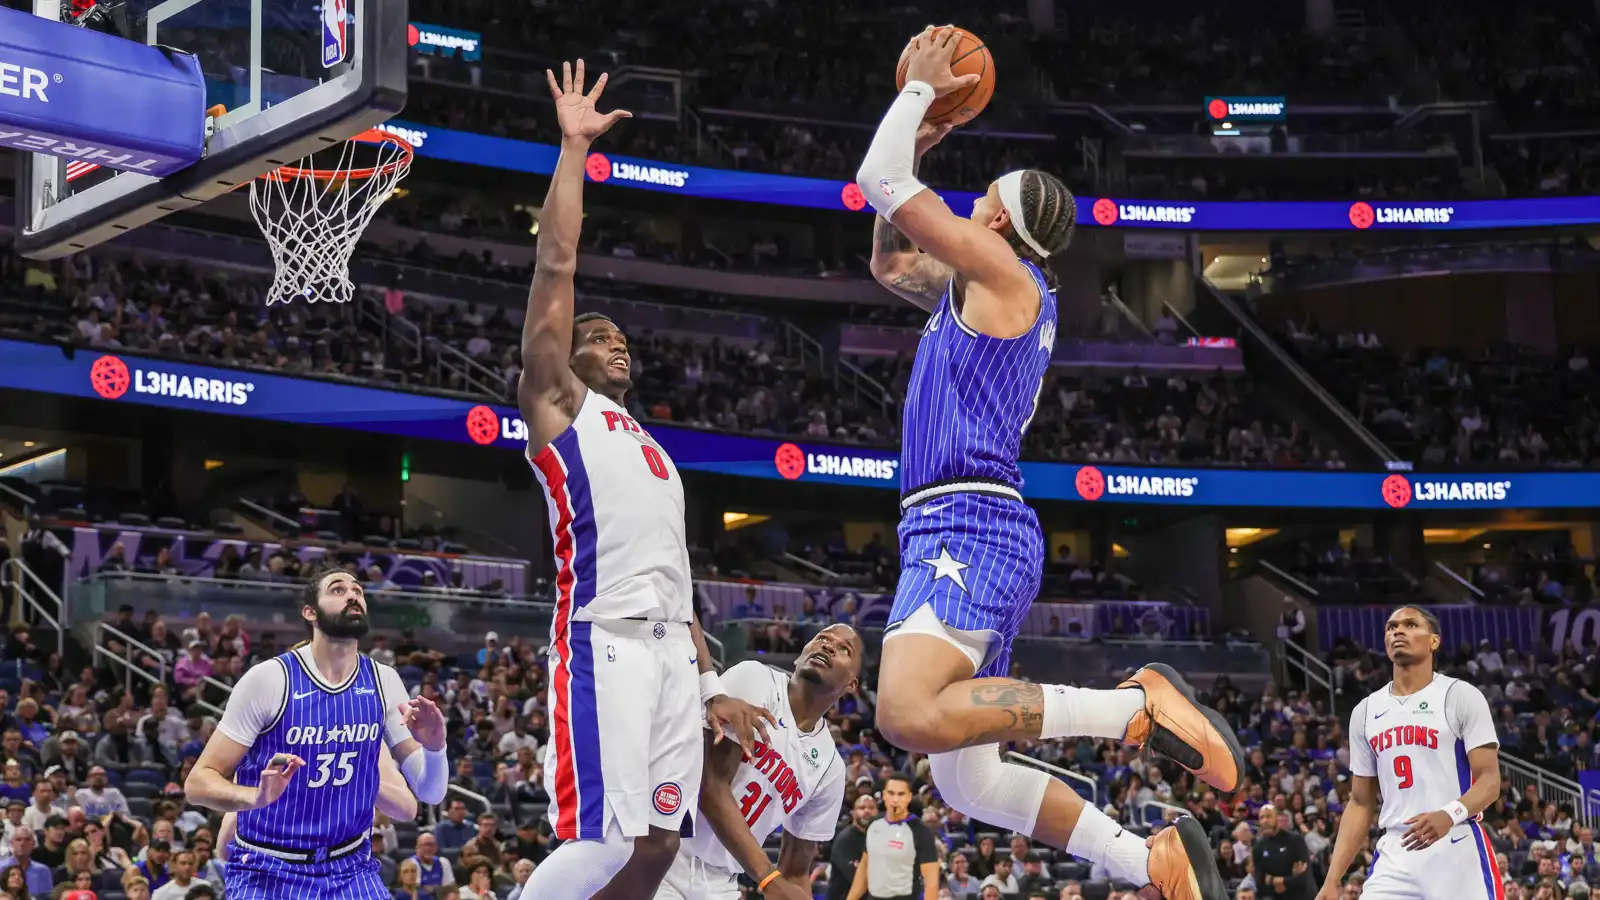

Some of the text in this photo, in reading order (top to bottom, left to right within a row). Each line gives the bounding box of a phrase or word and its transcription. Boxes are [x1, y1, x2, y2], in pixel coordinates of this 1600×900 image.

[325, 43, 337, 61] NBA
[1228, 103, 1282, 115] L3HARRIS
[612, 162, 686, 187] L3HARRIS
[1119, 205, 1192, 223] L3HARRIS
[1376, 207, 1451, 223] L3HARRIS
[135, 369, 250, 405] L3HARRIS
[641, 445, 670, 480] 0
[807, 453, 895, 479] L3HARRIS
[1107, 474, 1195, 497] L3HARRIS
[1414, 482, 1508, 500] L3HARRIS
[1369, 725, 1439, 758] PISTONS
[307, 751, 358, 788] 35
[1393, 755, 1414, 790] 9
[740, 781, 772, 828] 31
